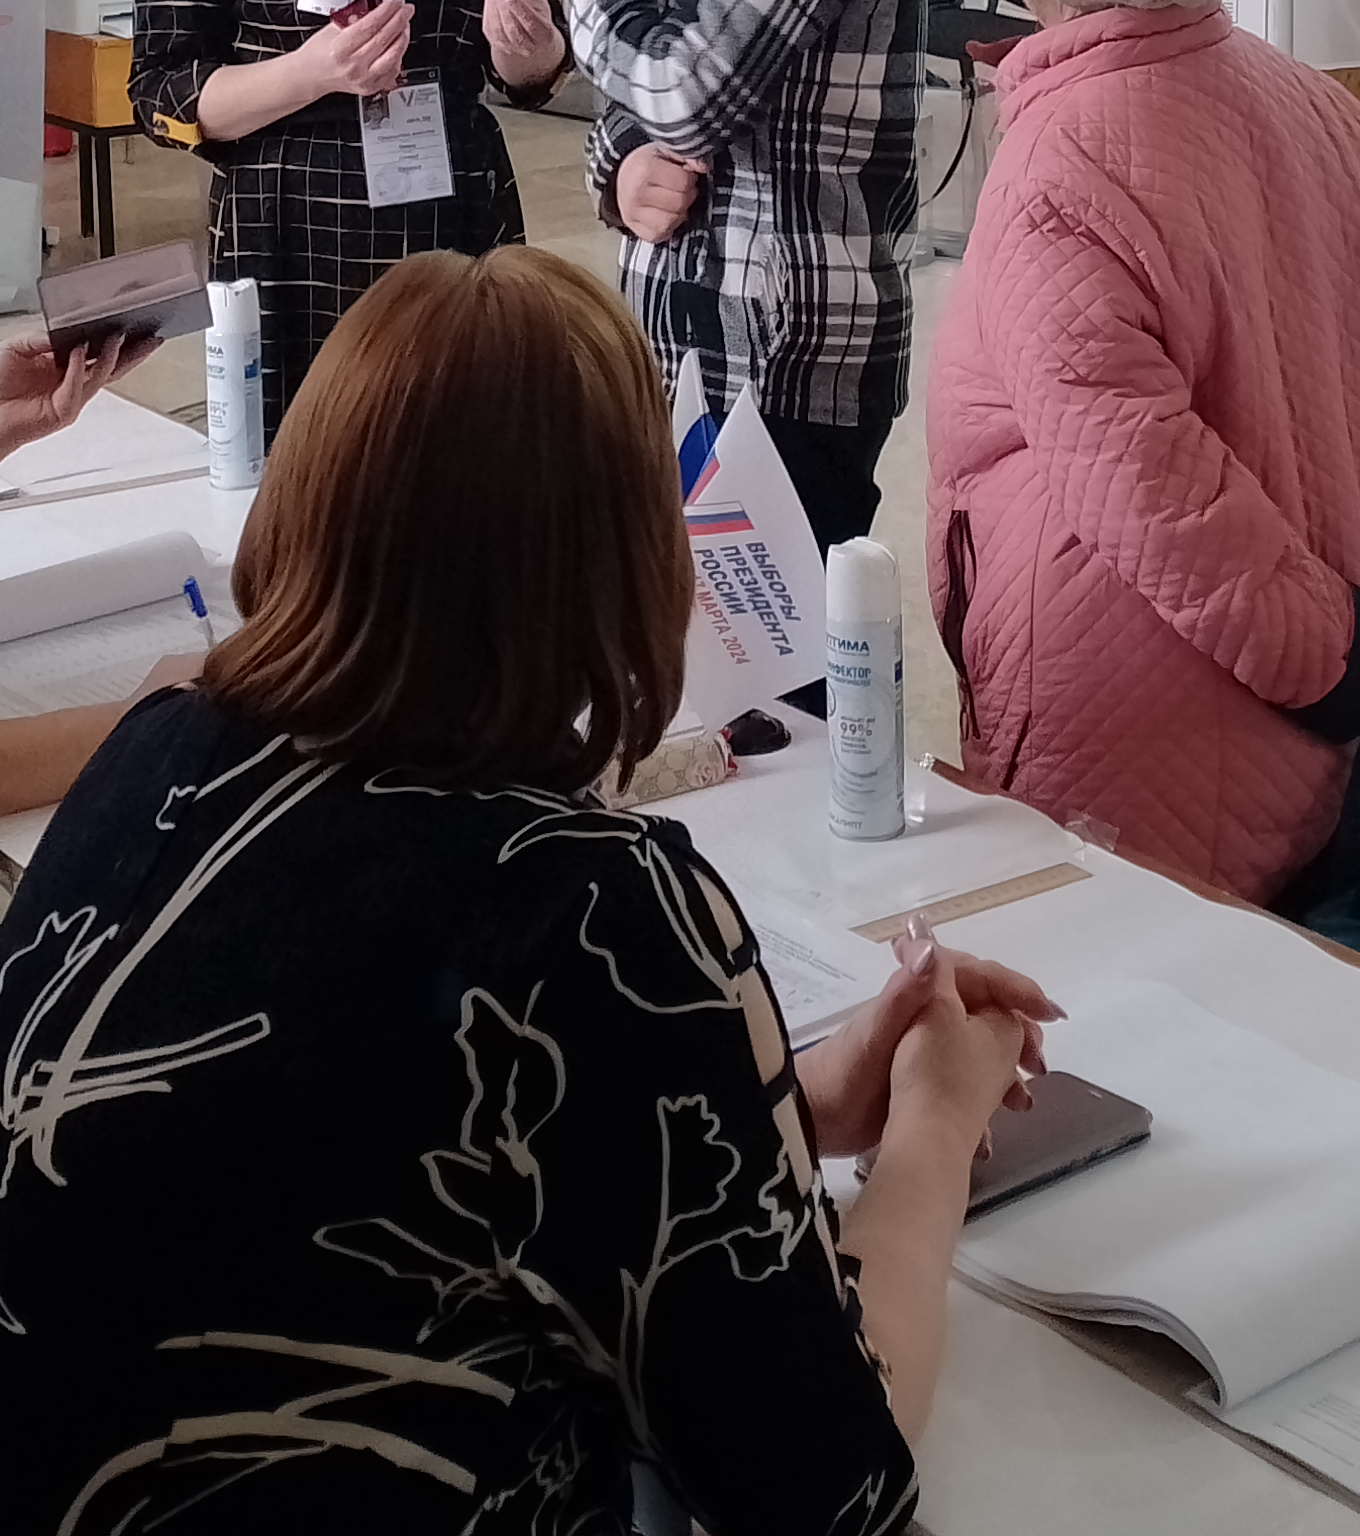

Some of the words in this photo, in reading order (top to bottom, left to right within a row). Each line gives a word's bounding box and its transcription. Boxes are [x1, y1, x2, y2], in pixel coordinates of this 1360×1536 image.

[694, 548, 748, 615] РОССИИ
[719, 545, 794, 656] ПРЕЗИДЕНТА
[745, 542, 801, 621] ВЫБОРЫ
[697, 590, 732, 635] МАРТА
[721, 636, 751, 665] 2024
[840, 722, 873, 736] 99%
